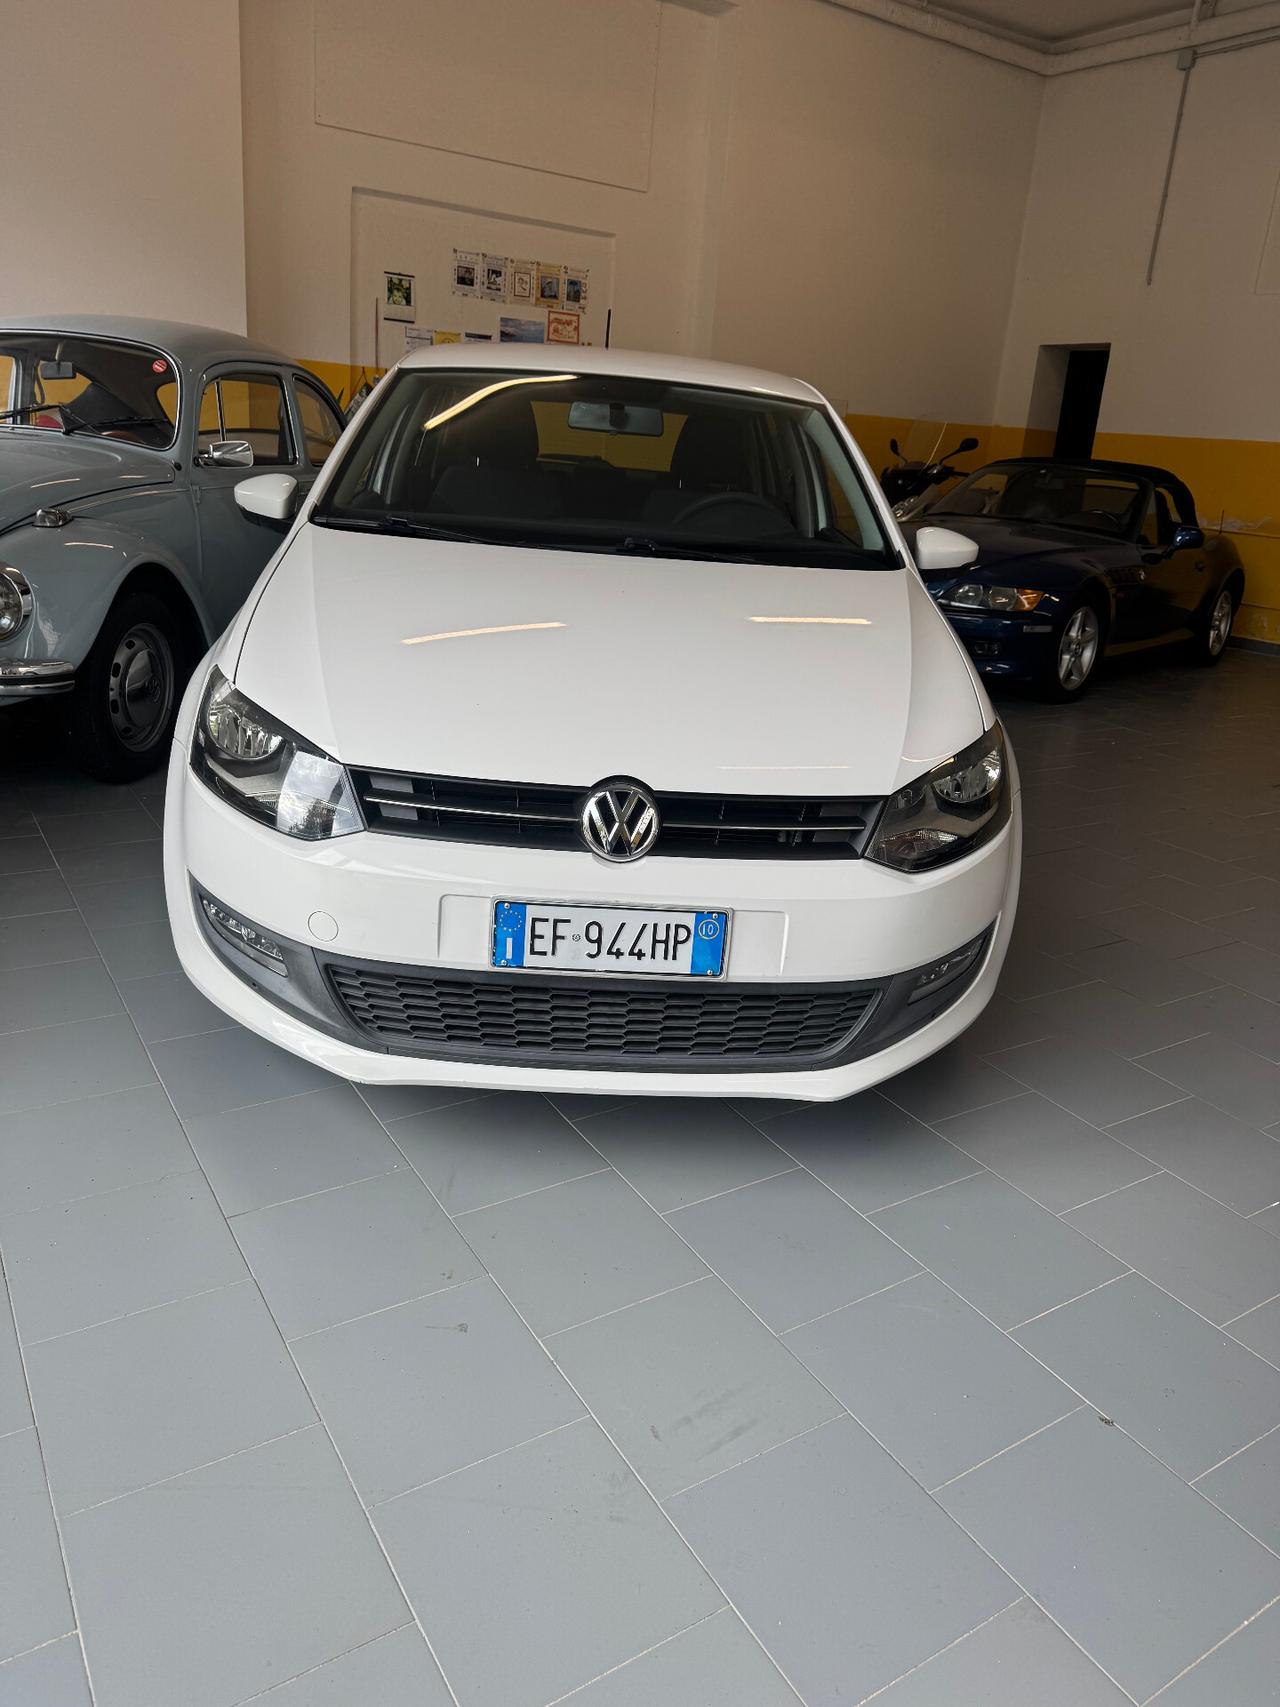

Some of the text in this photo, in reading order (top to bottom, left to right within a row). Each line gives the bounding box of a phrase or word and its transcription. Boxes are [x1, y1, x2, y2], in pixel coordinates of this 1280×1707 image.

[583, 786, 658, 860] VW
[529, 917, 692, 961] EF 944HP
